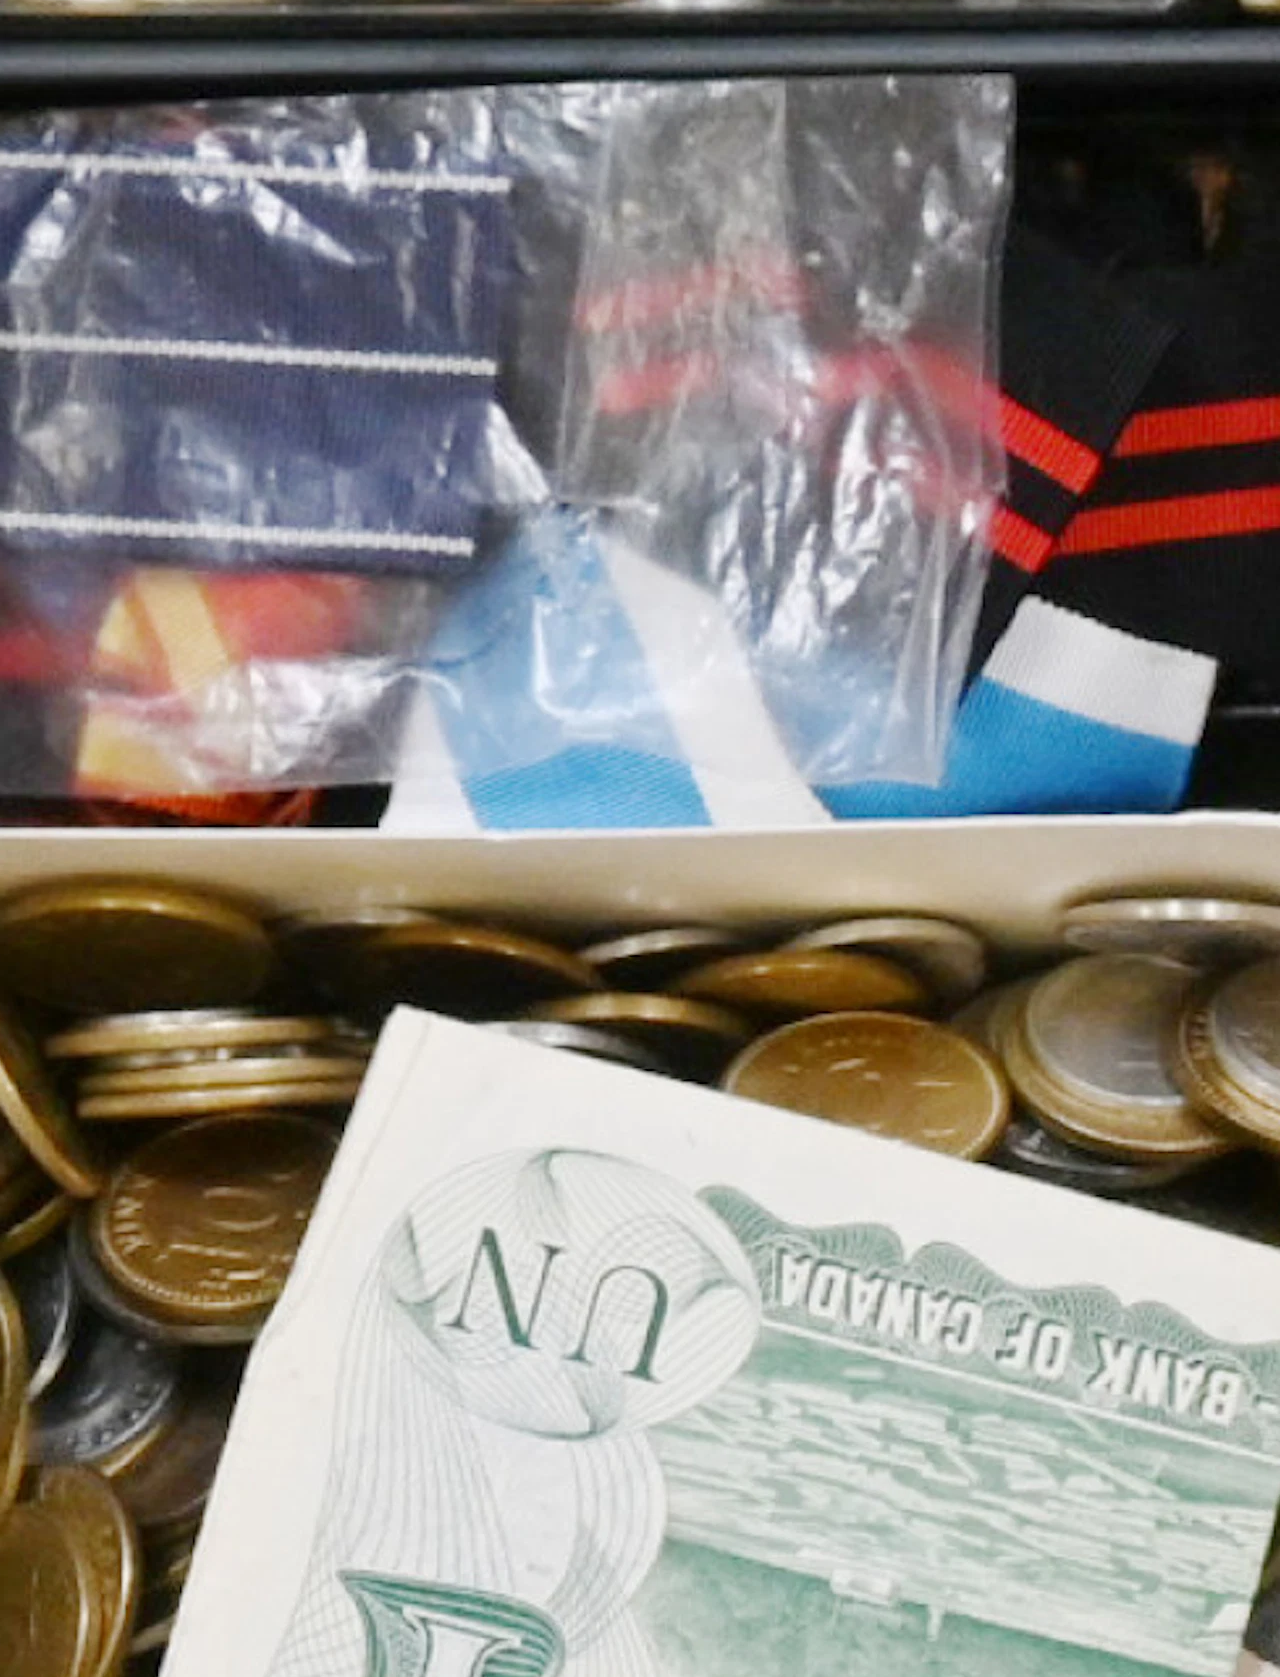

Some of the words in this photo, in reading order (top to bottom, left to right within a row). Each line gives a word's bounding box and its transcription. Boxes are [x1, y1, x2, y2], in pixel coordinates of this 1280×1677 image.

[440, 1226, 665, 1384] UN
[773, 1247, 984, 1356] CANADA
[995, 1311, 1073, 1380] OF
[1092, 1332, 1246, 1425] BANK
